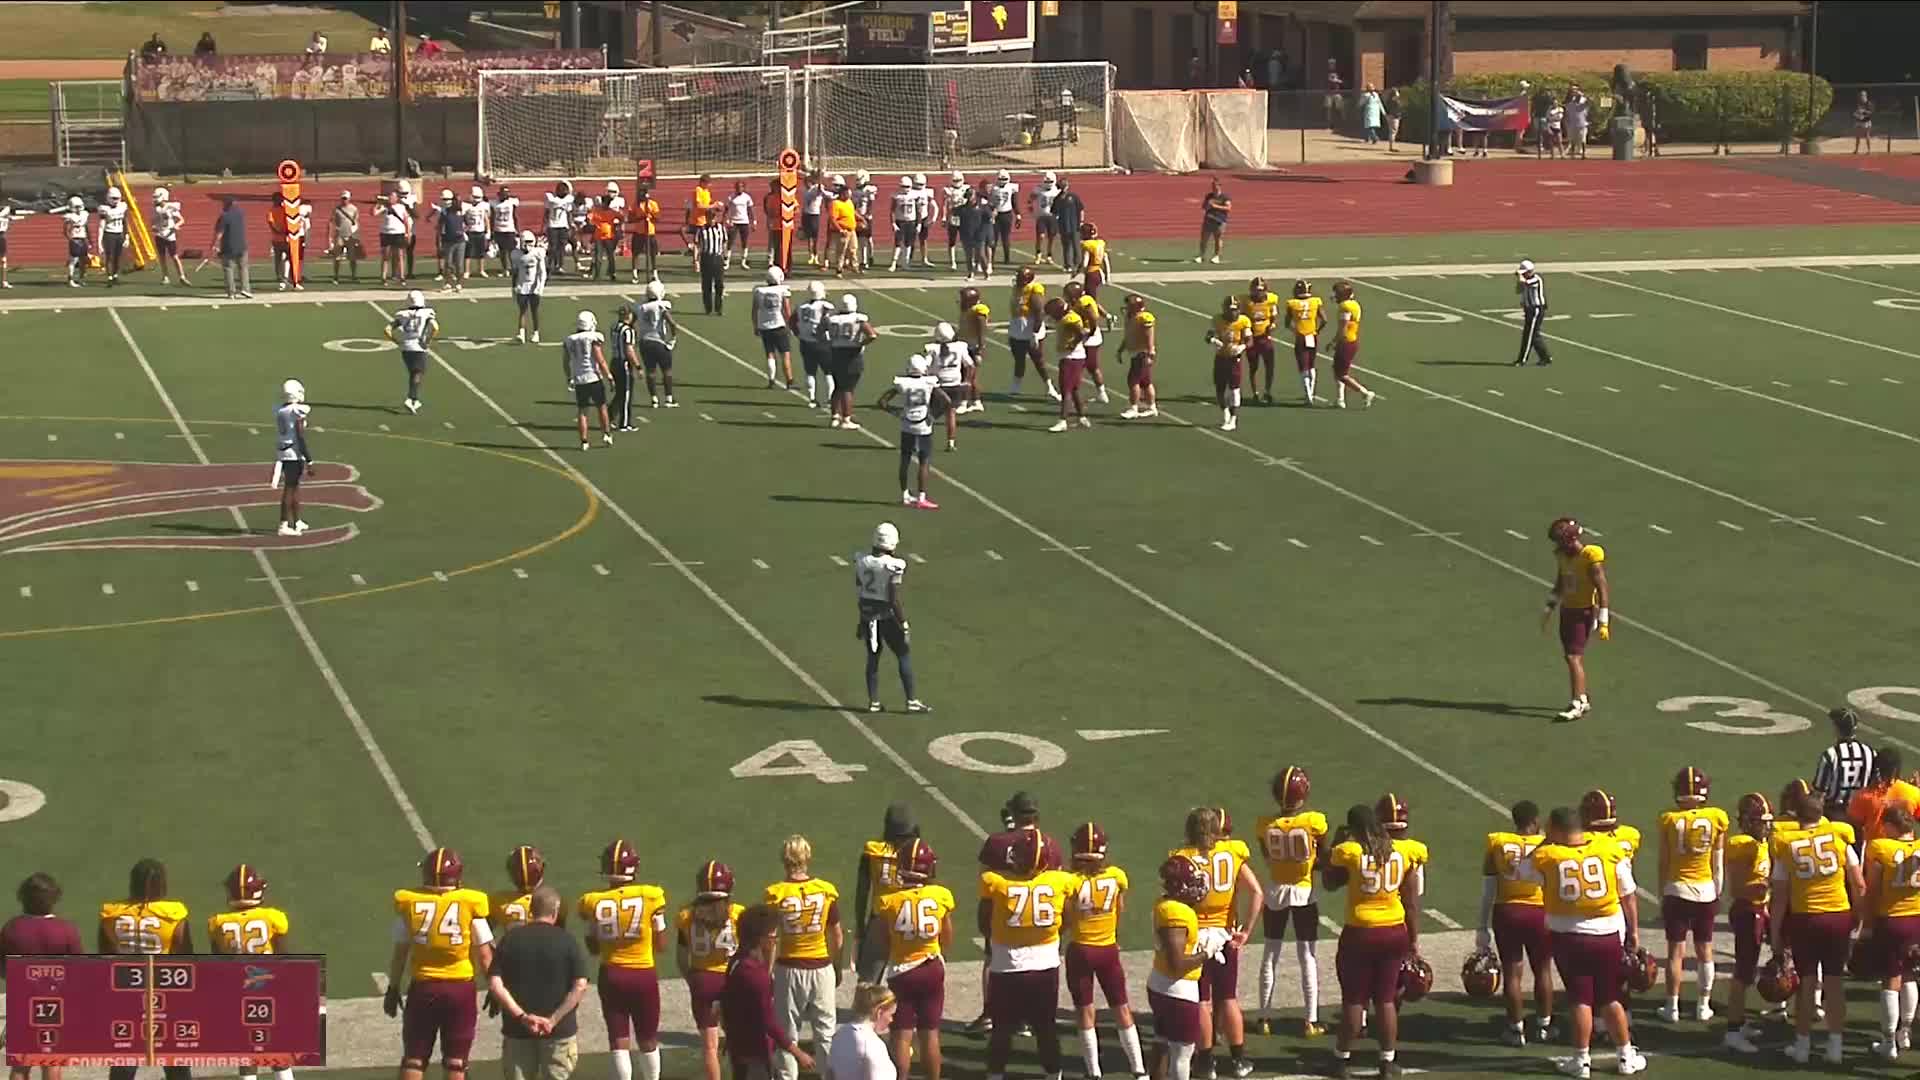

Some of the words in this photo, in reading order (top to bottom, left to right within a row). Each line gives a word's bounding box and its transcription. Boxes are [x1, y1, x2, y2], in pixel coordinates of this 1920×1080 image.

[863, 569, 877, 593] 2
[1841, 760, 1863, 789] H
[1790, 833, 1839, 880] 55
[1078, 877, 1118, 912] 47
[1558, 856, 1608, 901] 69
[414, 902, 464, 945] 74
[781, 894, 825, 934] 27
[896, 897, 940, 940] 46
[1007, 884, 1056, 927] 76
